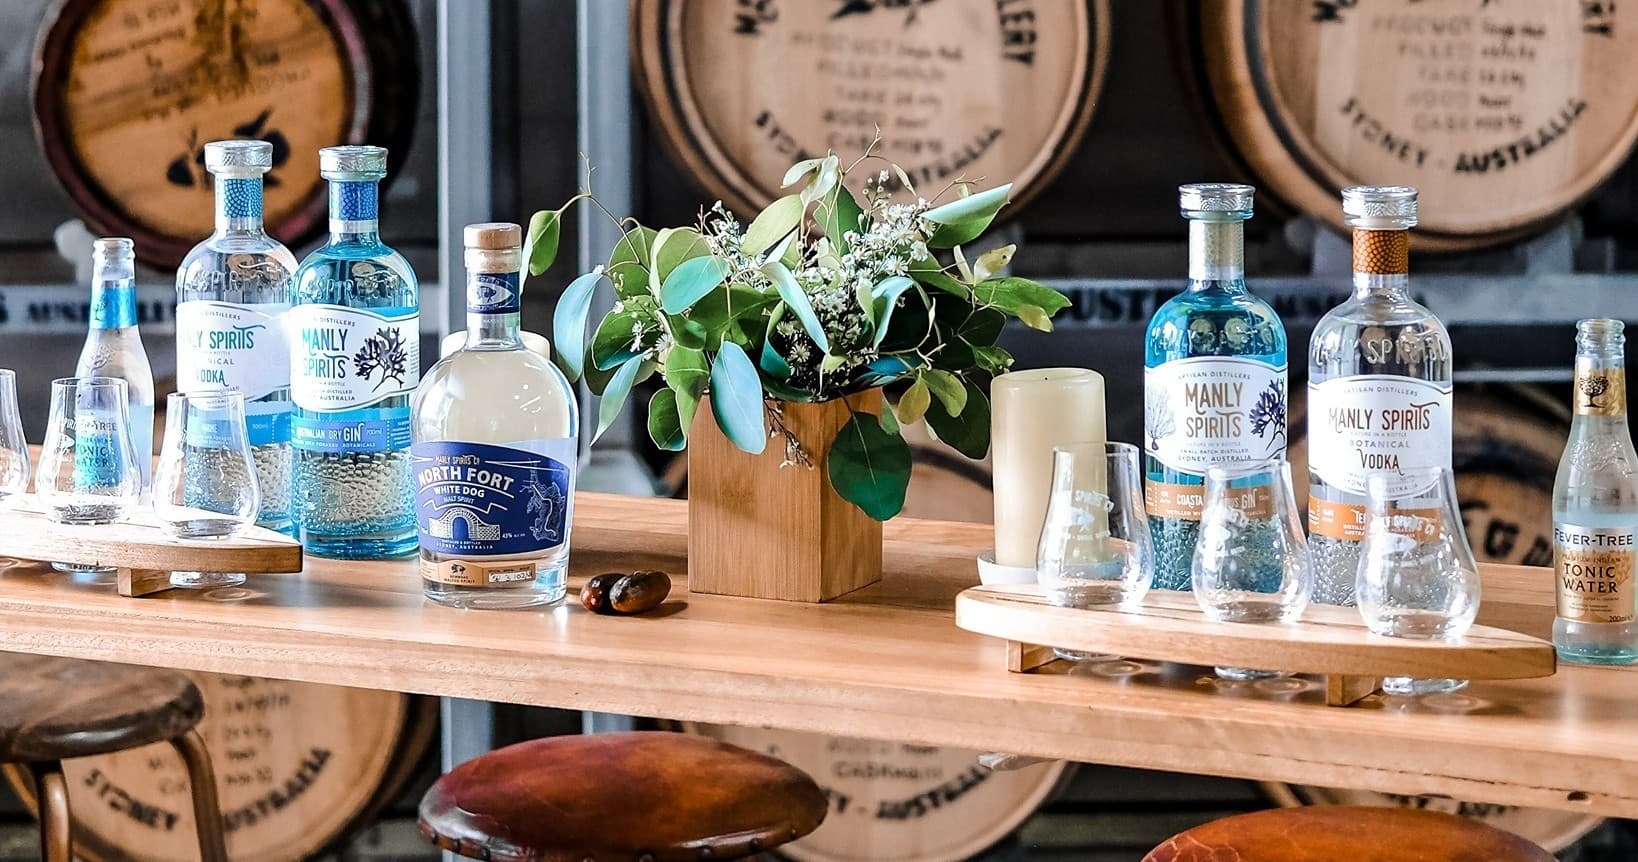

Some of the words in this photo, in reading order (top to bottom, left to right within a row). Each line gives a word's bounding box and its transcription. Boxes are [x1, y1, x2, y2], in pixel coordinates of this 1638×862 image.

[1341, 96, 1427, 168] SYDNEY
[1454, 97, 1587, 173] AUSTRALIA
[209, 324, 266, 350] SPIRITS
[302, 327, 348, 356] MANLY
[303, 352, 350, 380] SPIRITS
[1210, 371, 1251, 381] DISTILLERS
[1185, 382, 1243, 415] MANLY
[1376, 386, 1418, 398] DISTILLERS
[1185, 410, 1245, 439] SPIRITS
[1328, 407, 1373, 434] MANLY
[1381, 401, 1440, 431] SPIRITS
[328, 430, 342, 440] DRY
[343, 422, 364, 442] GIN
[1350, 440, 1411, 449] BOTANICAL
[1210, 454, 1251, 462] AUSTRALIA
[1356, 448, 1405, 476] VODKA
[418, 466, 461, 486] NORTH
[467, 467, 514, 491] FORT
[434, 485, 460, 495] WHITE
[463, 486, 485, 498] DOG
[1177, 493, 1204, 509] COASTA
[1241, 488, 1258, 508] GIN
[1554, 527, 1633, 546] FEVER-TREE
[1564, 562, 1616, 578] TONIC
[1562, 577, 1618, 593] WATER
